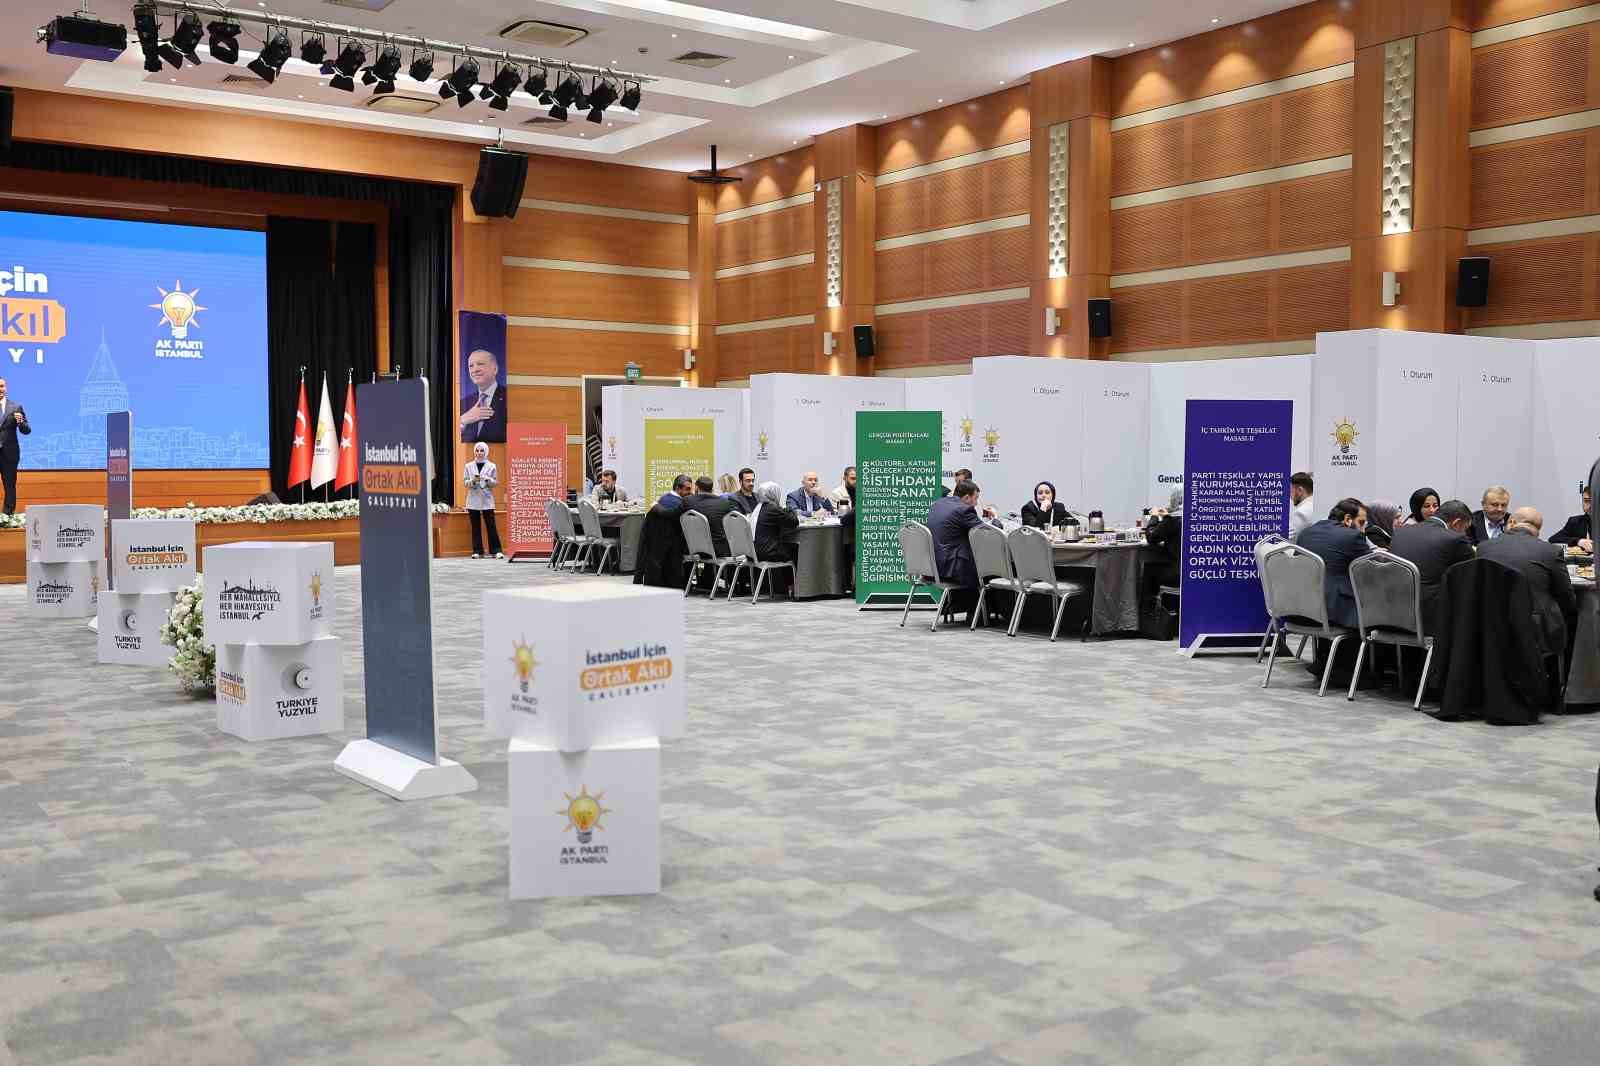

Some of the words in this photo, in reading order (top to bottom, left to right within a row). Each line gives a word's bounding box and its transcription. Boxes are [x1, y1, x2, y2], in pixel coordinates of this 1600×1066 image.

[0, 266, 48, 297] çin
[2, 303, 49, 336] kıl
[156, 339, 173, 349] AK
[1410, 370, 1432, 380] Oturum
[365, 442, 399, 462] İstanbul
[400, 442, 416, 465] İçin
[871, 458, 904, 467] KÜLTÜREL
[366, 470, 393, 488] Ortak
[871, 473, 936, 487] İSTİHDAM
[1218, 470, 1256, 480] TEŞKİLAT
[1199, 480, 1283, 490] KURUMSALLAŞMA
[892, 487, 935, 498] SANAT
[1255, 496, 1283, 505] TEMSİL
[863, 513, 898, 523] AİDİYET
[1190, 522, 1282, 532] SÜRDÜRÜLEBİLİRLİK
[863, 530, 900, 540] MOTİVA
[1190, 533, 1231, 543] GENÇLİK
[1232, 534, 1265, 542] KOLLA
[1190, 545, 1224, 554] KADIN
[1226, 545, 1256, 554] KOLL
[1189, 556, 1228, 566] ORTAK
[1230, 555, 1257, 566] VİZY
[870, 563, 905, 573] GÖNÜLL
[1189, 567, 1227, 580] GÜÇLÜ
[586, 647, 640, 665] İstanbul
[583, 666, 632, 689] Ortak
